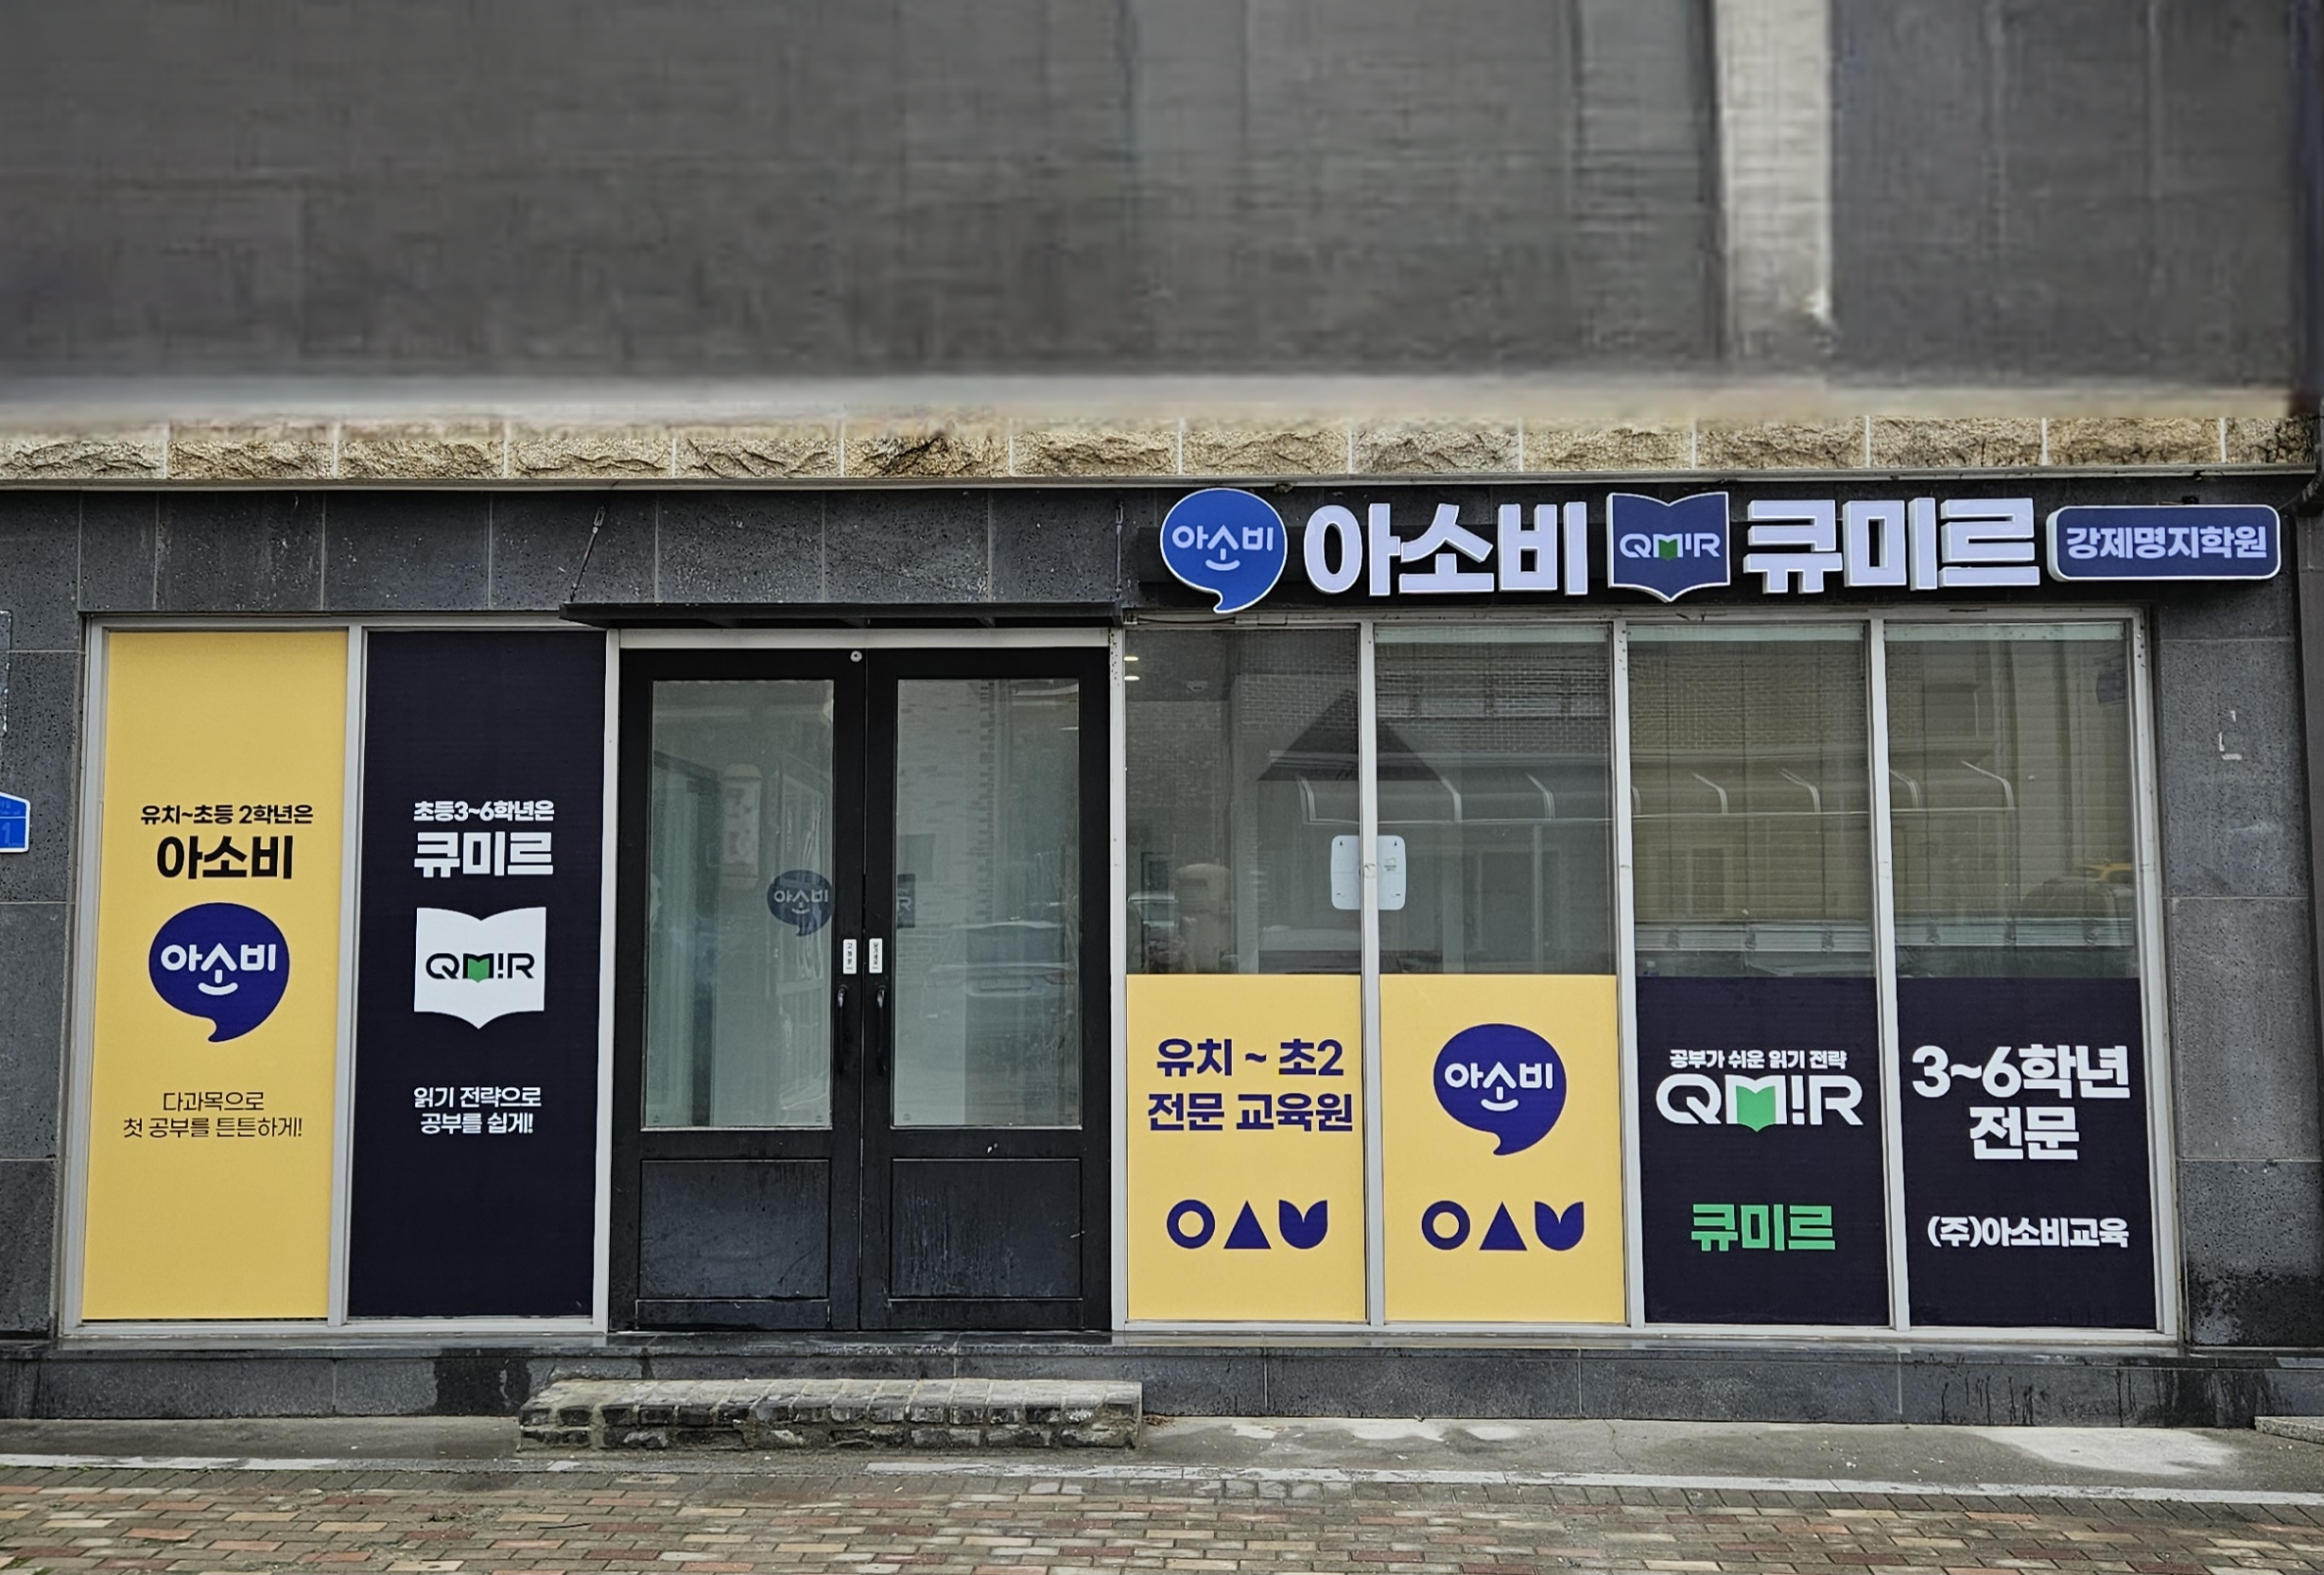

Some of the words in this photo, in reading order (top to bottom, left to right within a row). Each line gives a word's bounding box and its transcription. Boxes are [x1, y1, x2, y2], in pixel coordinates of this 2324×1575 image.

[1171, 525, 1274, 571] 아소비
[1303, 501, 1588, 597] 아소비
[1743, 497, 2040, 594] 큐미르
[2066, 526, 2268, 560] 강제명지학원
[141, 805, 234, 824] 유치~초등
[239, 805, 313, 824] 2학년은
[413, 800, 555, 822] 초등3~6학년은
[156, 835, 293, 879] 아소비
[414, 831, 554, 878] 큐미르
[773, 889, 829, 914] 아소비
[160, 943, 277, 995] 아소비
[1156, 1038, 1233, 1077] 유치
[1278, 1038, 1344, 1077] 초2
[1670, 1049, 1725, 1068] 공부가
[1727, 1049, 1765, 1068] 쉬운
[1768, 1049, 1806, 1068] 읽기
[1809, 1049, 1847, 1069] 전략
[1912, 1044, 2130, 1099] 3~6학년
[163, 1092, 265, 1112] 다과목으로
[413, 1086, 455, 1108] 읽기
[460, 1086, 542, 1108] 전략으로
[1444, 1062, 1553, 1113] 아소비
[123, 1117, 143, 1138] 첫
[148, 1117, 210, 1138] 공부를
[216, 1116, 303, 1138] 튼튼하게!
[420, 1112, 482, 1134] 공부를
[487, 1112, 534, 1134] 쉽게!
[1148, 1092, 1225, 1132] 전문
[1236, 1093, 1353, 1132] 교육원
[1969, 1106, 2080, 1160] 전문
[1691, 1203, 1836, 1251] 큐미르
[1927, 1216, 2129, 1248] (주)아소비교육
